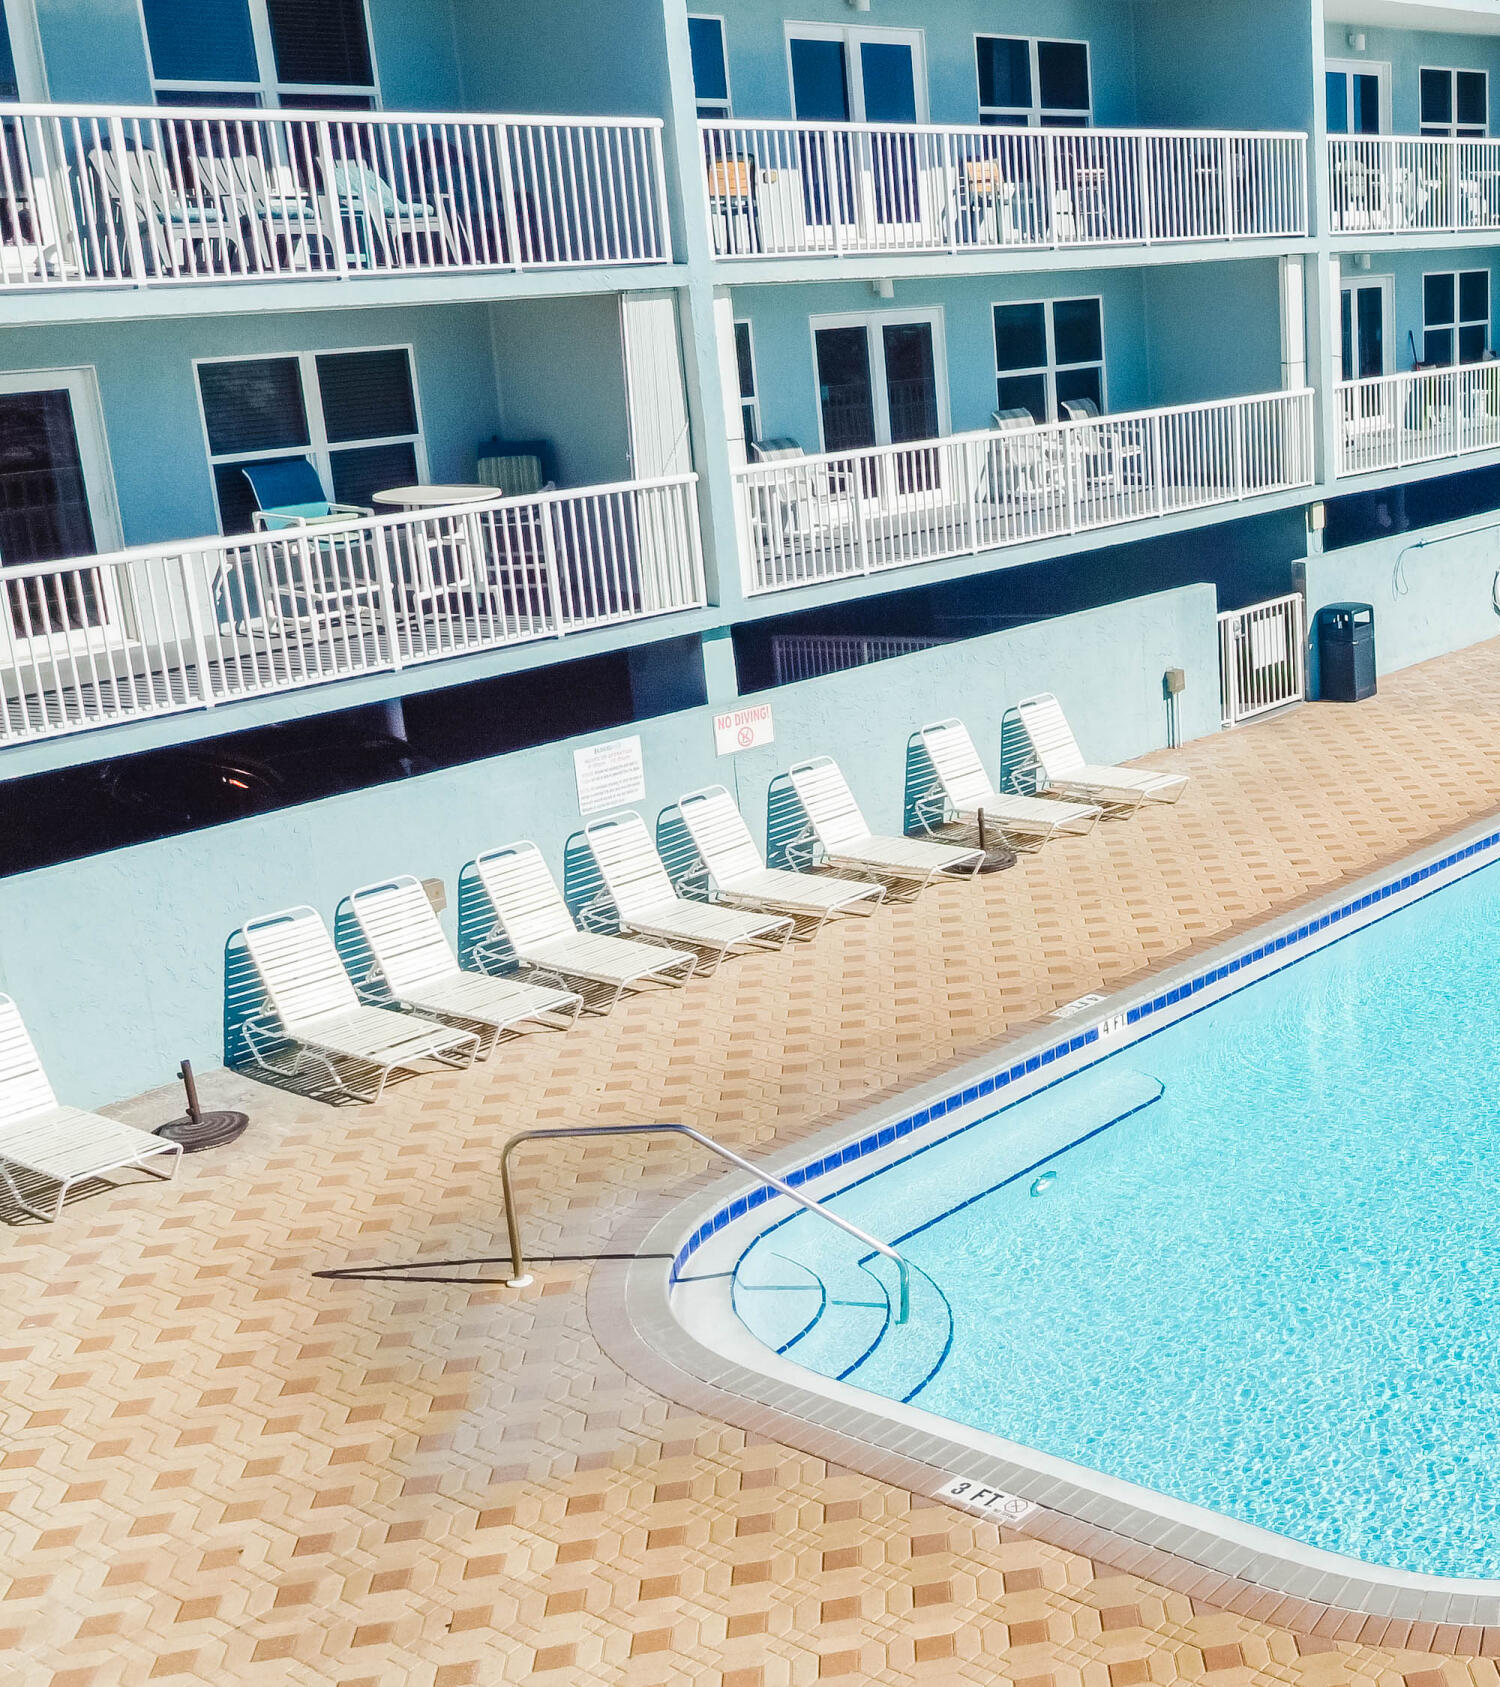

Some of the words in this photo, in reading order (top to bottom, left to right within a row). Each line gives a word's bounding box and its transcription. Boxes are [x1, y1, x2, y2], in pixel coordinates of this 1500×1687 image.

[717, 716, 732, 730] NO
[734, 705, 769, 727] DIVING!
[1103, 1021, 1110, 1035] 4
[1113, 1013, 1125, 1031] FT
[950, 1482, 972, 1495] 3
[969, 1488, 1005, 1506] FT
